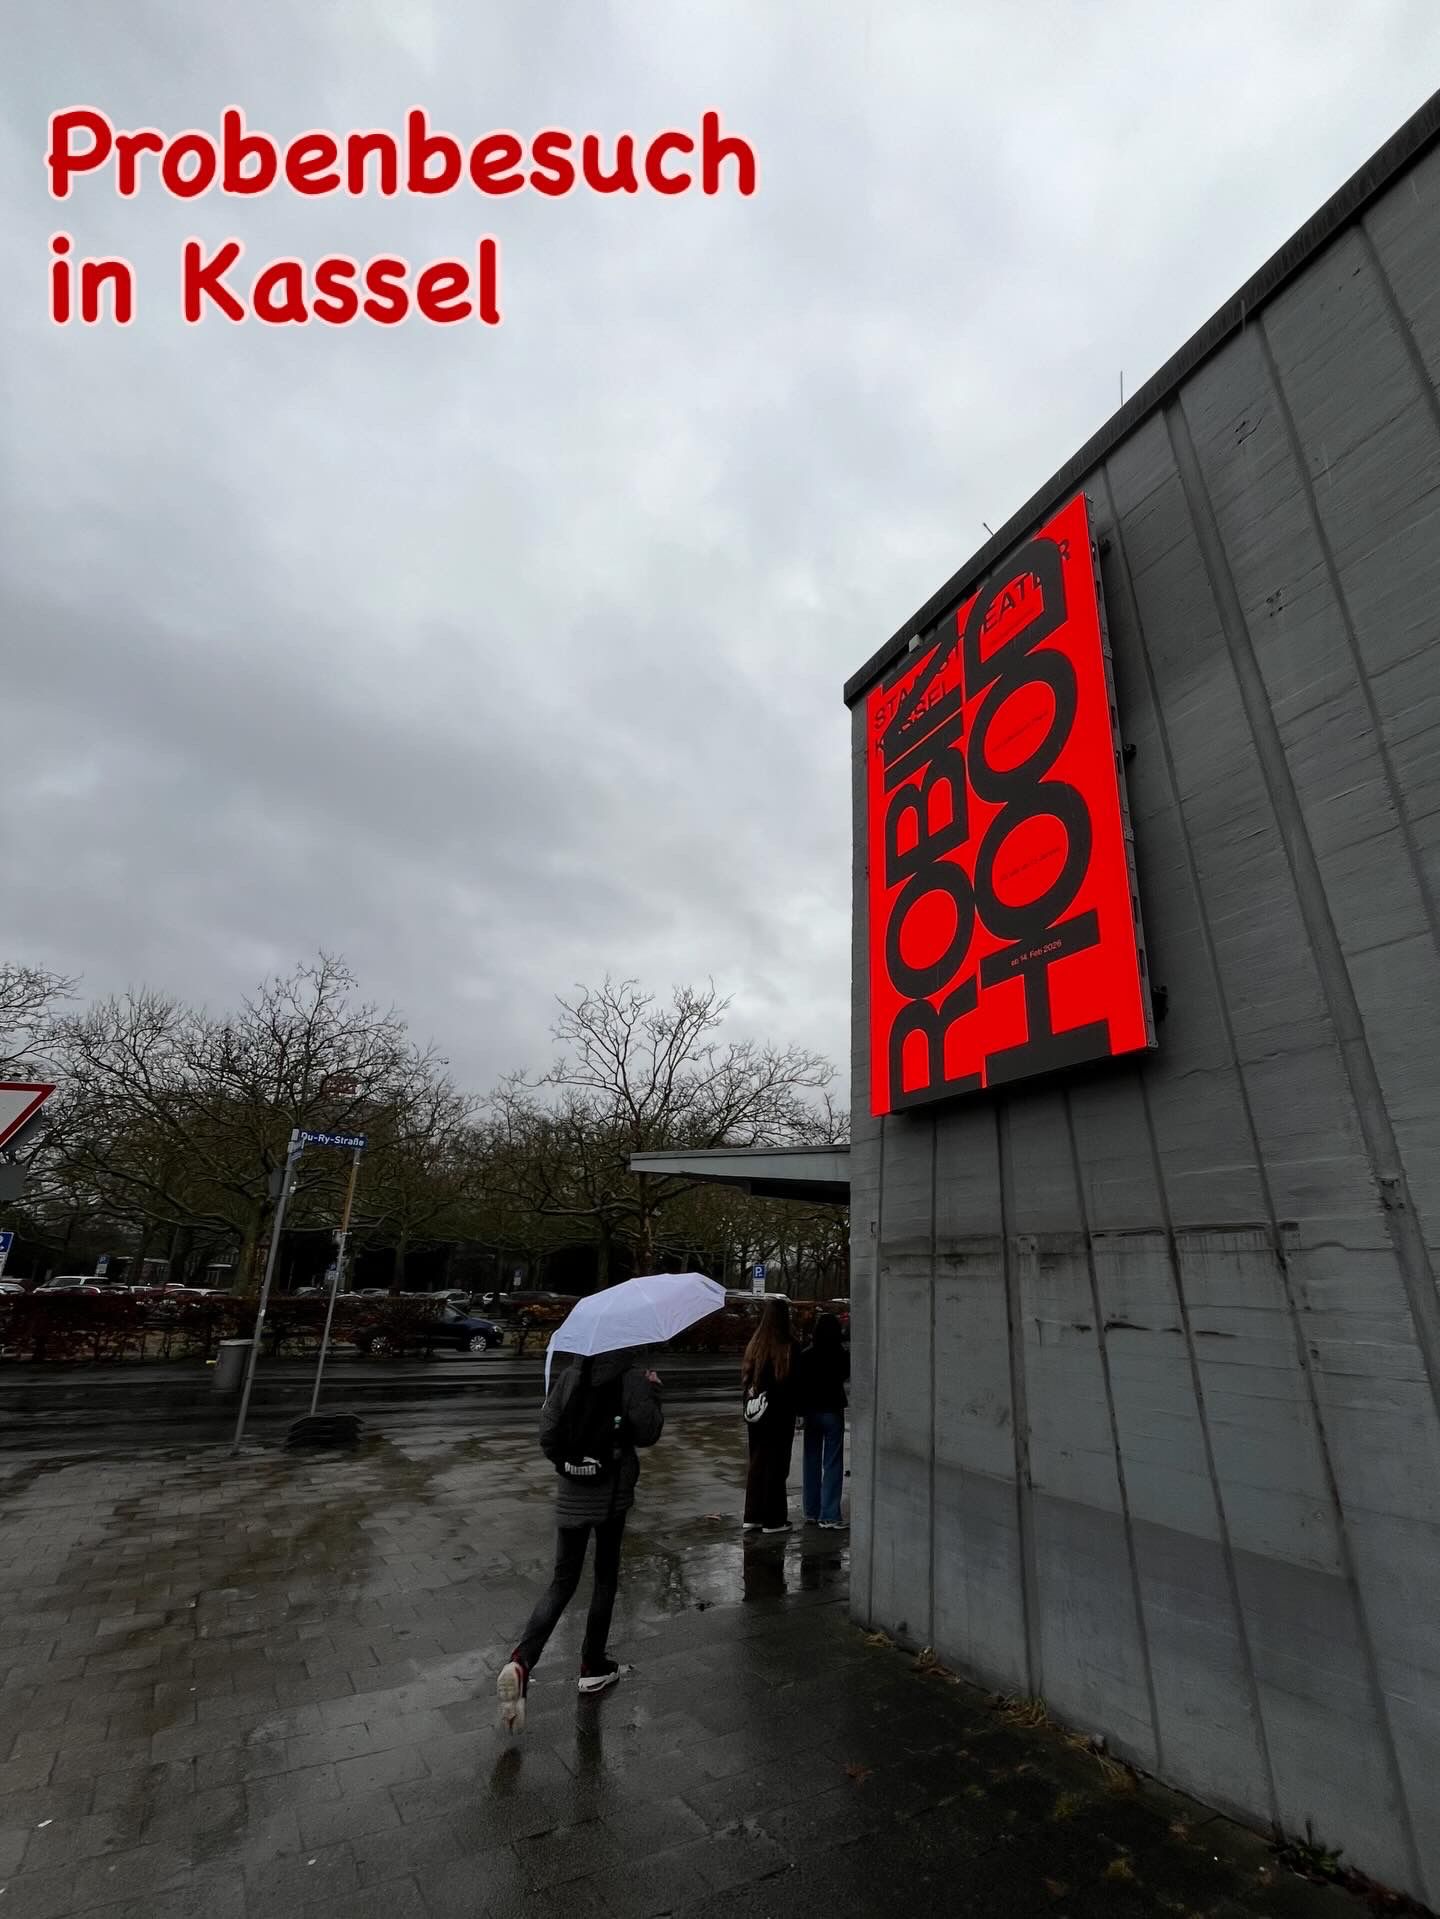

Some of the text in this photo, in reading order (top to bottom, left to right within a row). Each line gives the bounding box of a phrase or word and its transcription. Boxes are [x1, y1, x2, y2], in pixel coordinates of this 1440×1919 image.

[884, 610, 979, 1113] ROBIN
[963, 536, 1113, 1087] HOOD
[301, 1131, 364, 1147] Du-Ry-Straße
